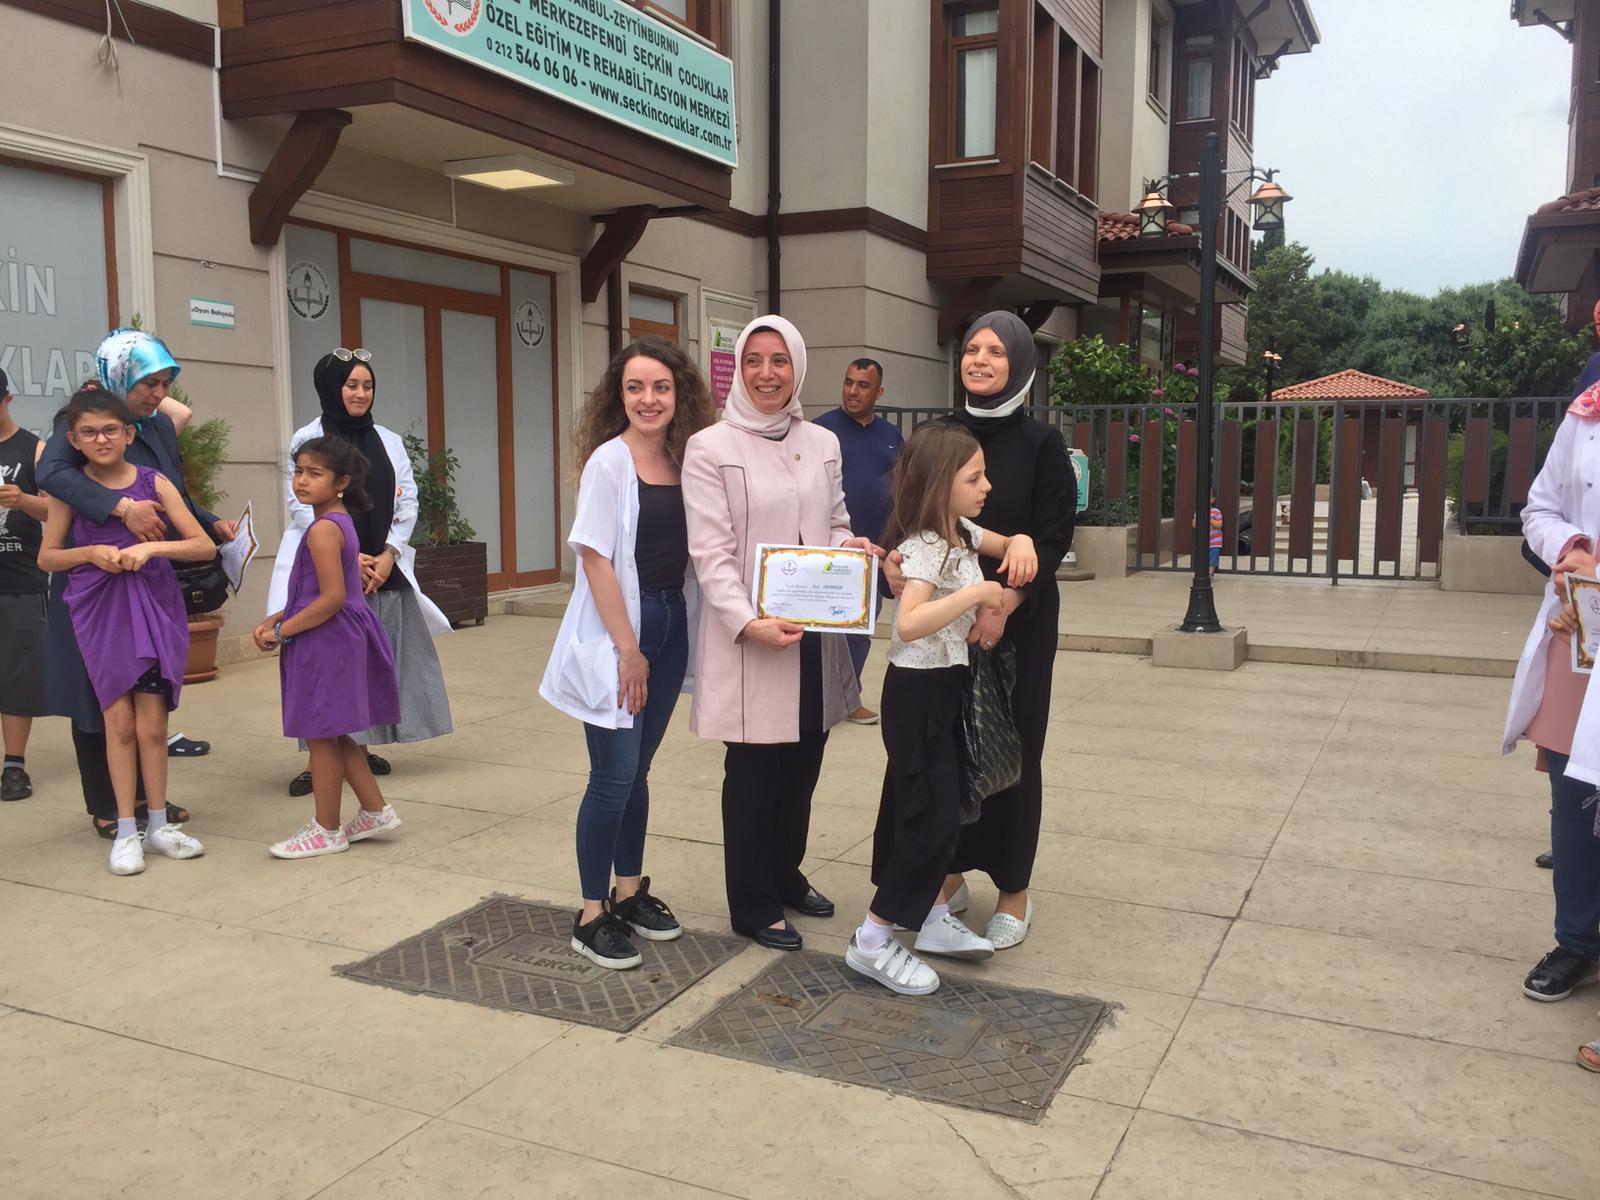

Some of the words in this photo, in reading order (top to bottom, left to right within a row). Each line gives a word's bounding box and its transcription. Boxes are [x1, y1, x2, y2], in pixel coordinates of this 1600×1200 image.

[495, 41, 513, 59] 212
[516, 43, 541, 71] 546
[544, 56, 560, 79] 06
[562, 65, 578, 87] 06
[589, 80, 732, 151] www.seckincocuklar.com.tr
[526, 21, 572, 59] EĞİTİM
[574, 44, 591, 68] VE
[593, 54, 687, 110] REHABİLİTASYON
[689, 98, 730, 130] MERKEZİ
[529, 0, 627, 56] MERKEZEFENDİ
[633, 45, 673, 78] SEÇKİN
[678, 66, 729, 105] ÇOCUKLAR
